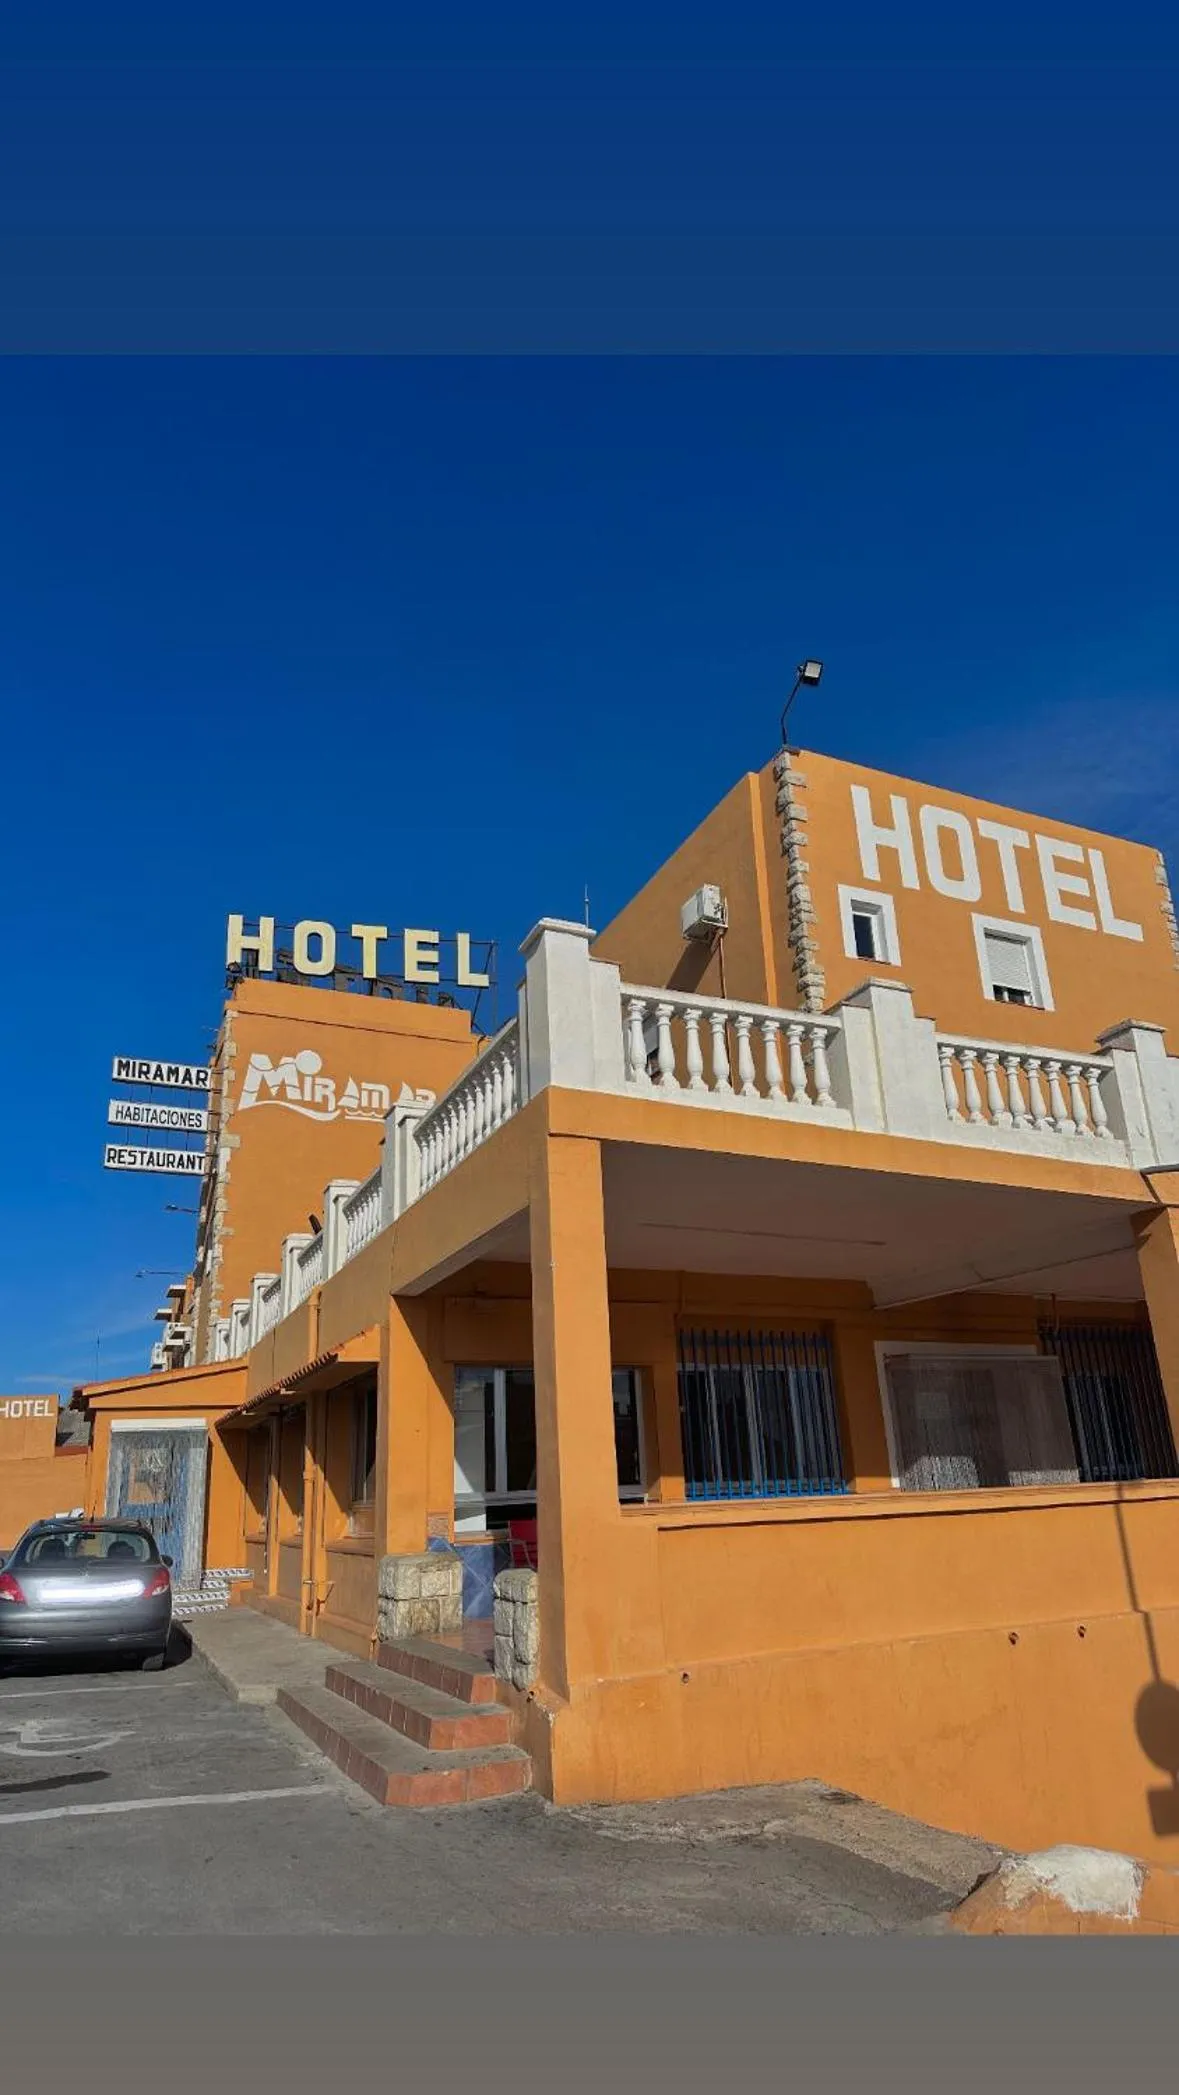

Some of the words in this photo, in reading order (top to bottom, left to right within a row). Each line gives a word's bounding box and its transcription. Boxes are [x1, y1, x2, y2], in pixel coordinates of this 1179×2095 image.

[851, 784, 1144, 942] HOTEL
[226, 914, 490, 987] HOTEL
[117, 1059, 208, 1087] MIRAMAR
[116, 1105, 202, 1128] HABITACIONES
[107, 1147, 206, 1170] RESTAURANT
